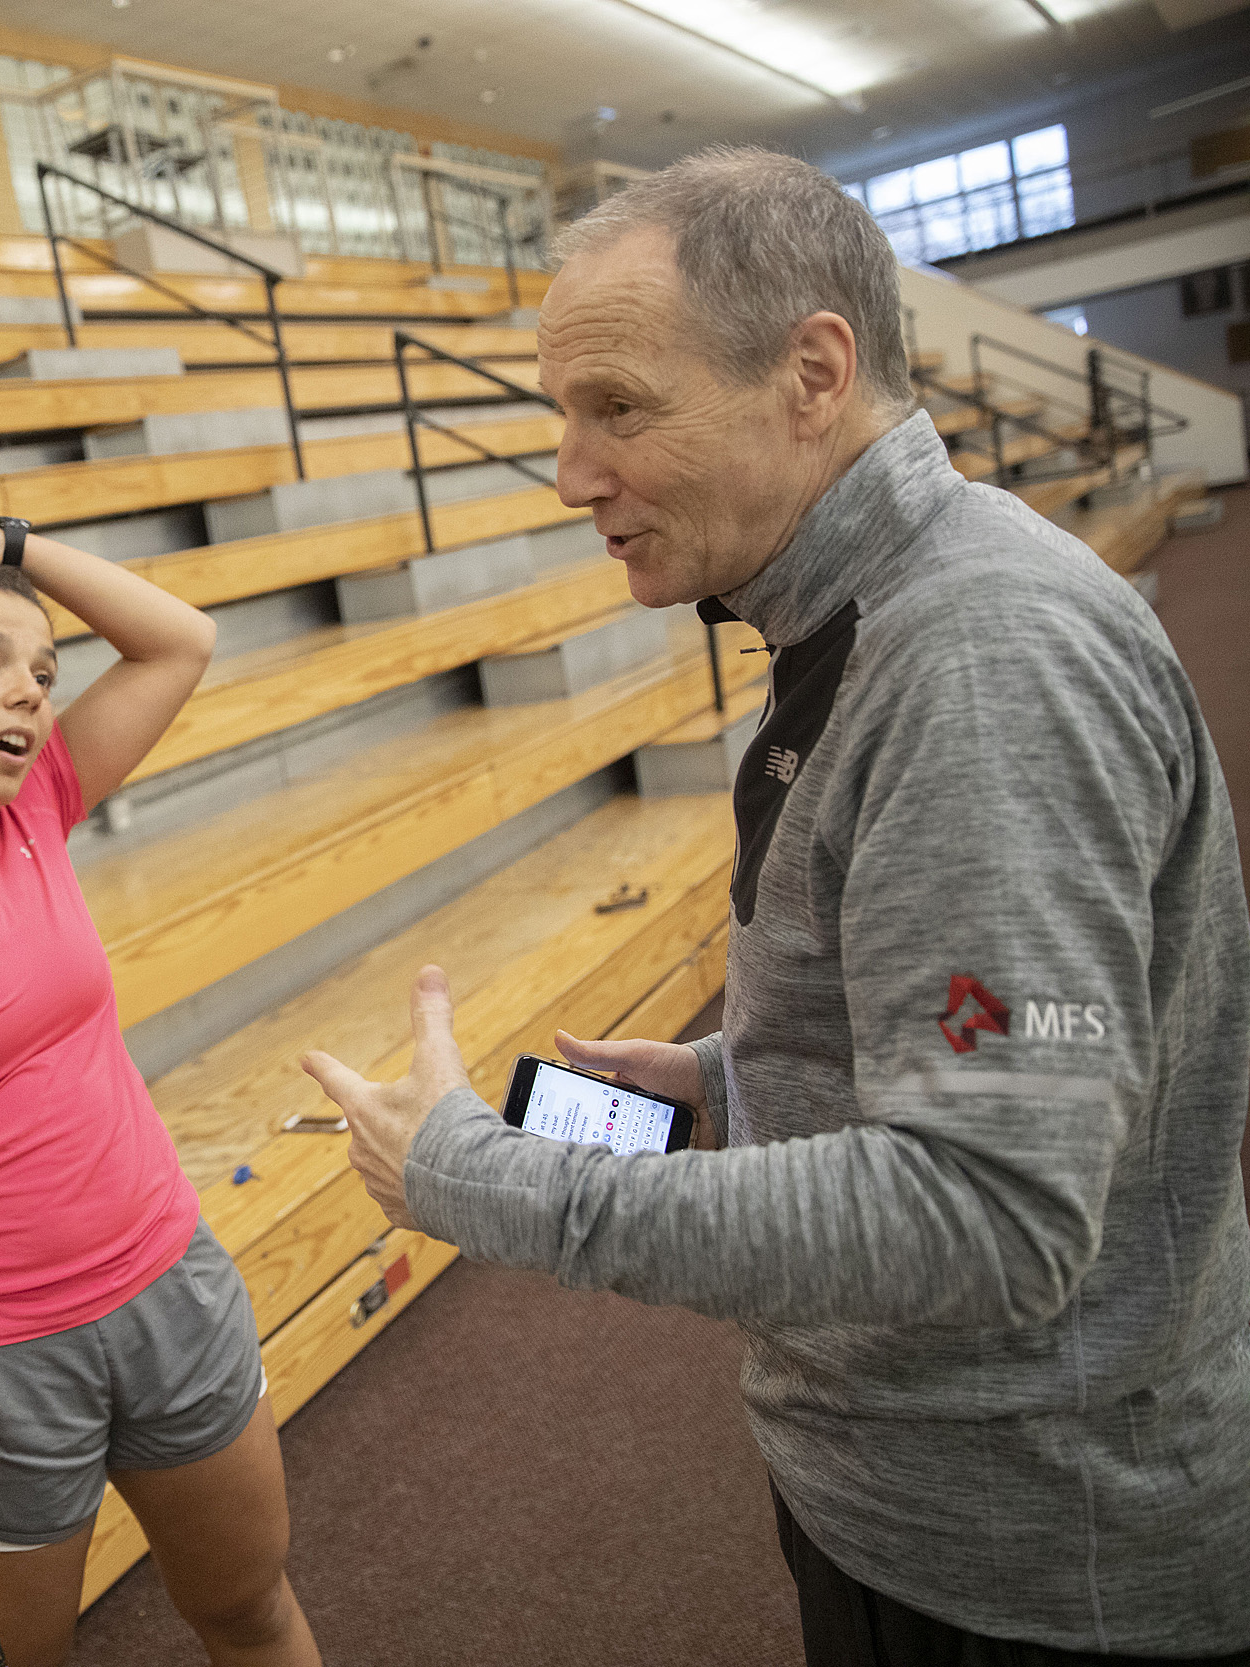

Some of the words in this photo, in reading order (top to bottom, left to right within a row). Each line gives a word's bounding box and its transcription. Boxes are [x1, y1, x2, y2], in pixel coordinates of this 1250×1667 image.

[1024, 999, 1106, 1041] MFS
[571, 1102, 580, 1125] tomorrow
[551, 1126, 557, 1134] my
[561, 1116, 570, 1135] thought
